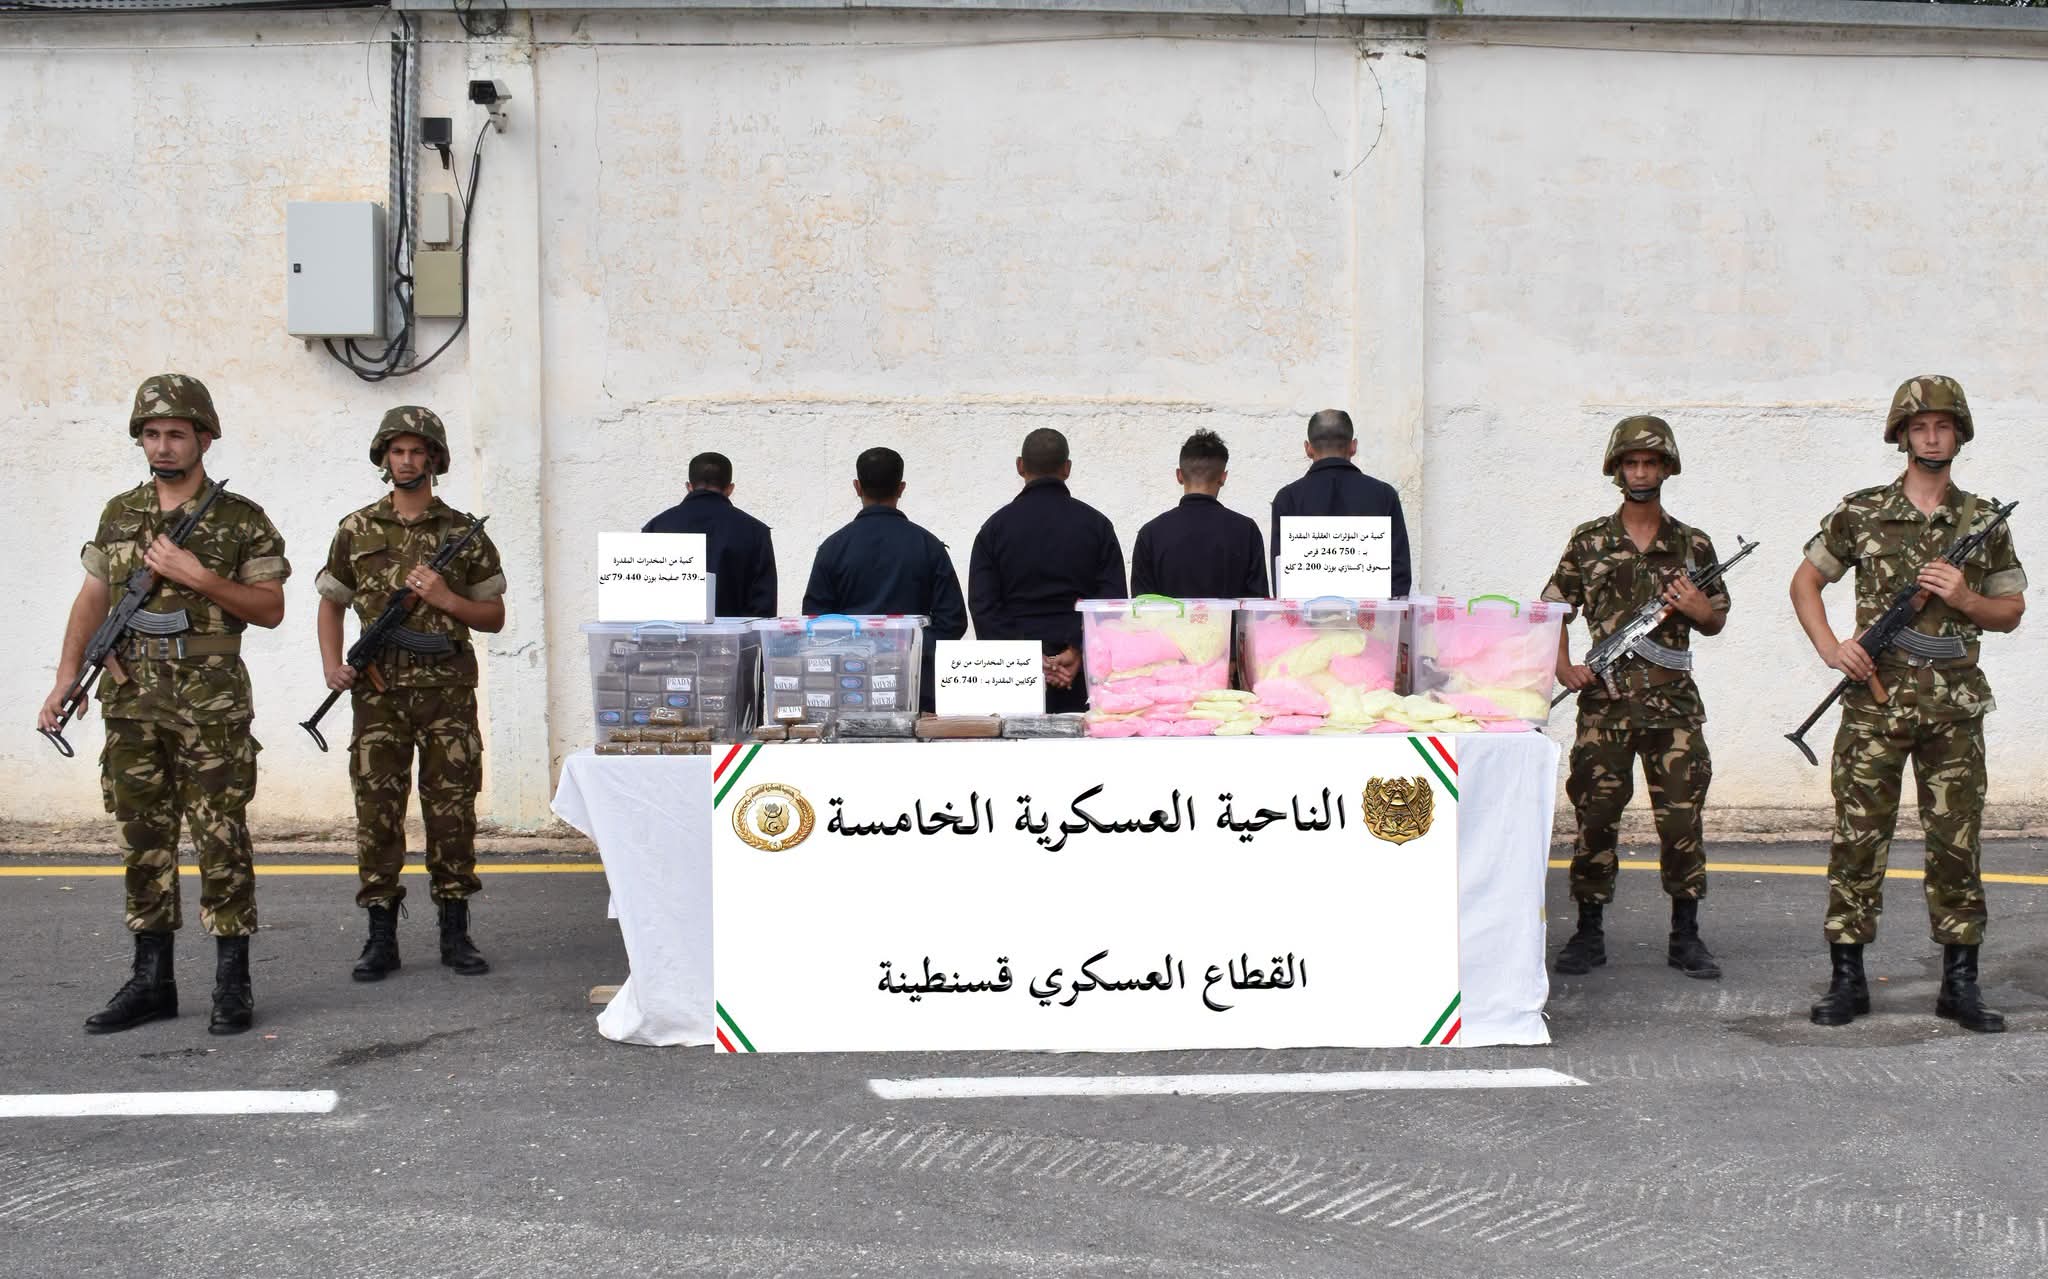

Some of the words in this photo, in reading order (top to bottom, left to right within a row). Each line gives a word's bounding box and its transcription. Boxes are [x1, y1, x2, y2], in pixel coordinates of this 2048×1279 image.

[1288, 532, 1310, 542] المقدرة
[1312, 532, 1331, 541] العقلية
[1360, 534, 1369, 542] من
[1371, 531, 1385, 541] كمية
[1303, 548, 1319, 558] قرص
[1321, 547, 1338, 556] 246
[1339, 547, 1356, 556] 750
[613, 557, 635, 567] المقدرة
[637, 557, 667, 567] المخدرات
[669, 559, 678, 567] من
[679, 556, 694, 565] كمية
[1324, 564, 1337, 573] بوزن
[644, 574, 658, 584] بوزن
[951, 660, 962, 670] نوع
[964, 661, 972, 669] من
[974, 659, 1004, 668] المخدرات
[1006, 661, 1015, 669] من
[1017, 658, 1032, 667] كمية
[992, 676, 1014, 687] المقدرة
[1015, 676, 1038, 688] كوكايين
[826, 790, 994, 837] الخامسة
[1014, 783, 1196, 853] العسكرية
[1216, 786, 1346, 844] الناحية
[877, 954, 1013, 1003] قسنطينة
[1028, 949, 1185, 1008] العسكري
[1202, 951, 1307, 1013] القطاع
